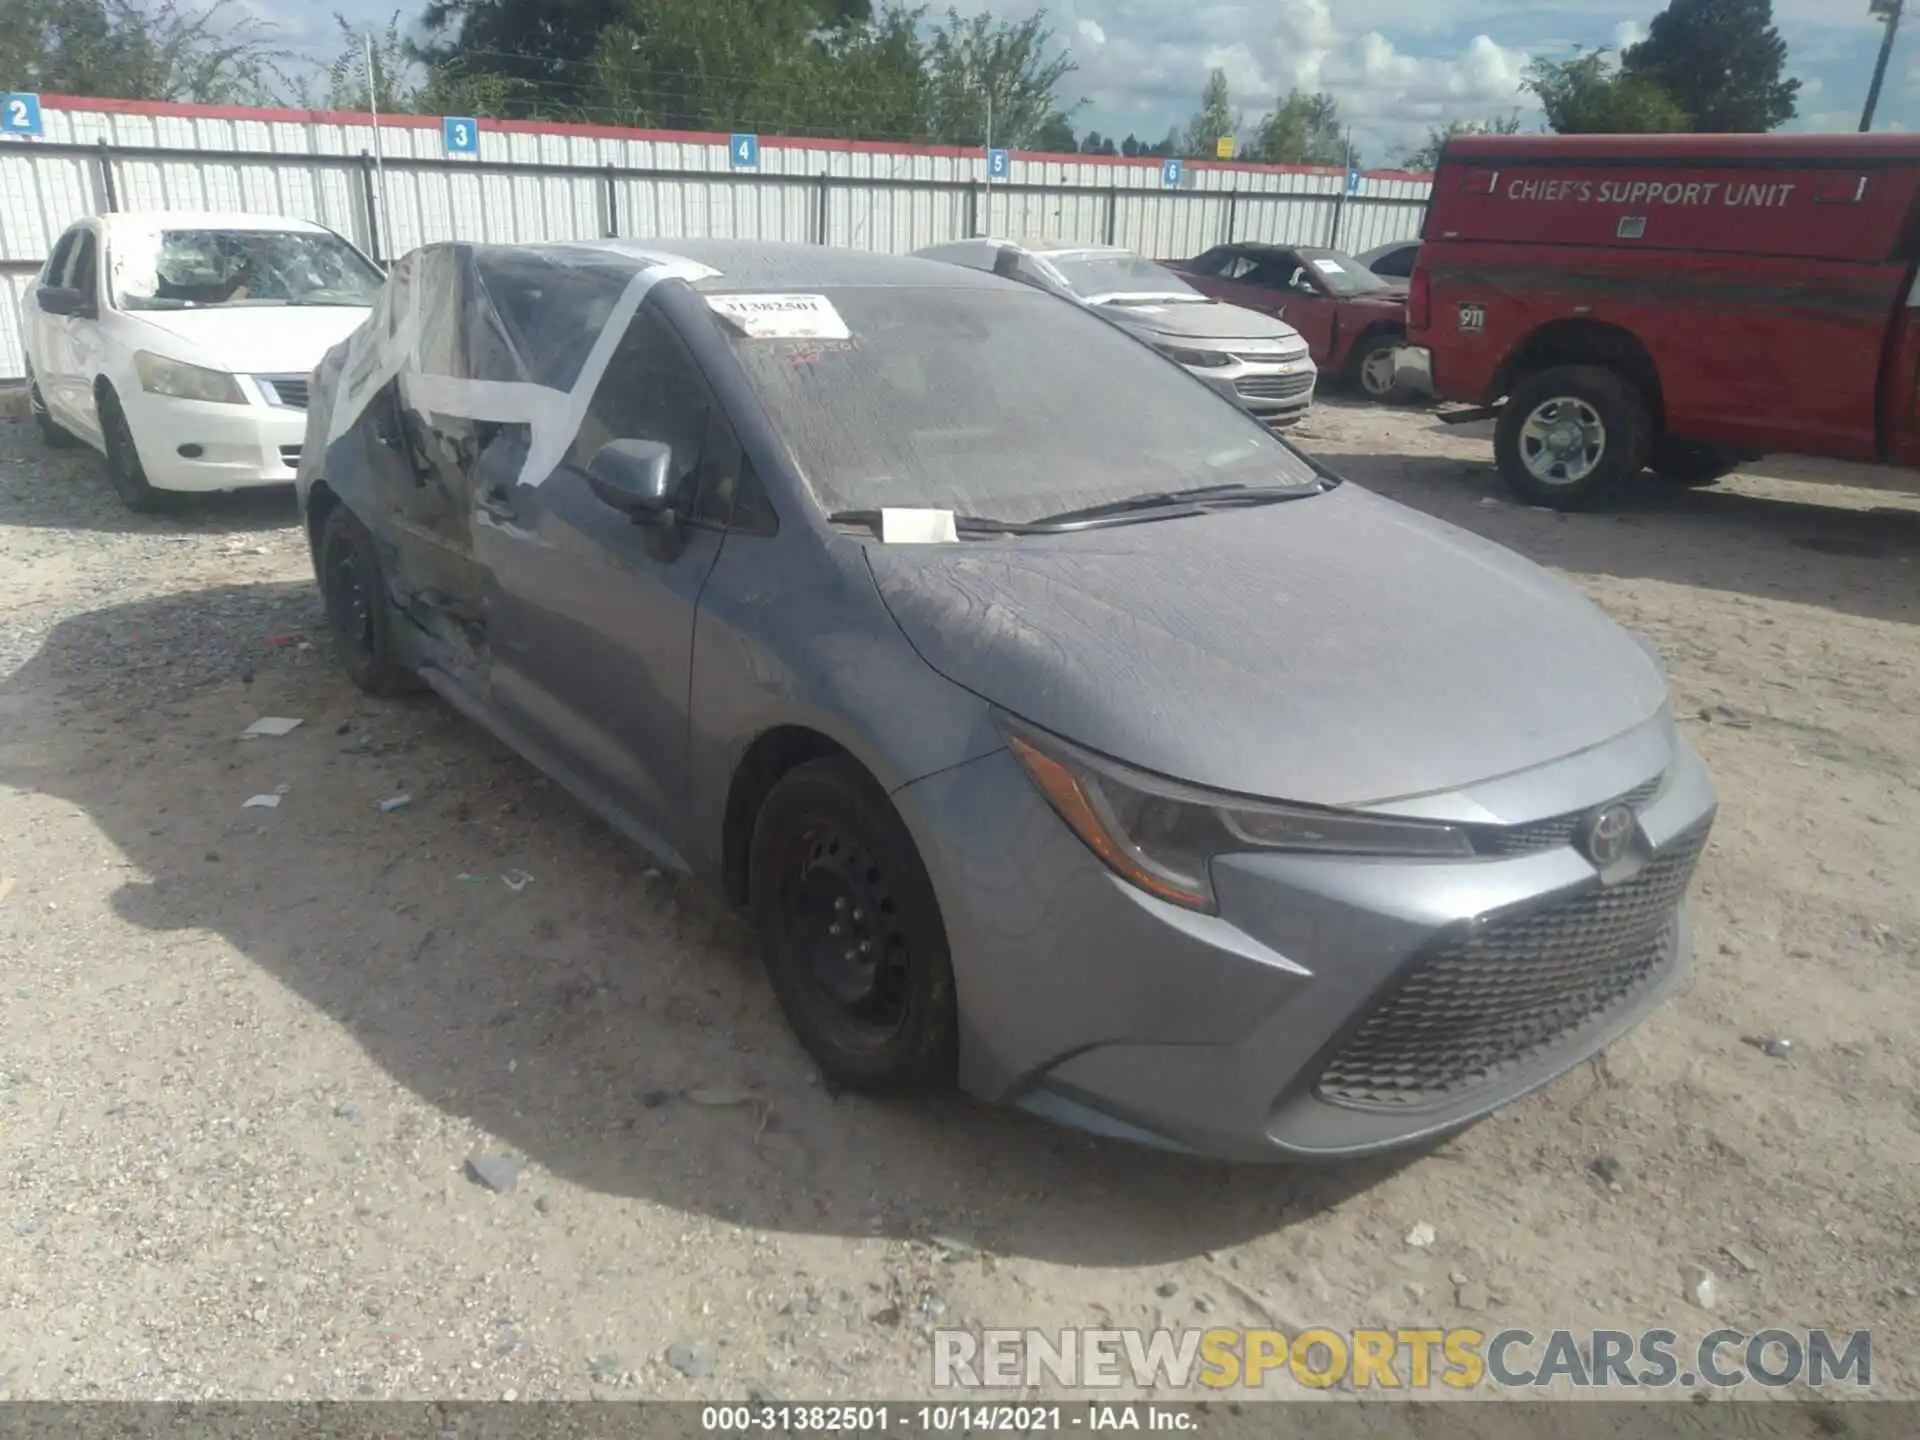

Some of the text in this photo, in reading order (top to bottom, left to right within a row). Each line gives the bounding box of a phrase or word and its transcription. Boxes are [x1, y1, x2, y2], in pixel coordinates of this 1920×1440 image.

[10, 100, 31, 126] 2
[454, 124, 469, 147] 3
[738, 141, 750, 162] 4
[994, 155, 1003, 173] 5
[1169, 164, 1177, 181] 6
[1351, 172, 1359, 187] 7
[1507, 179, 1796, 208] CHIEF'S SUPPORT UNIT
[1460, 308, 1483, 327] 911
